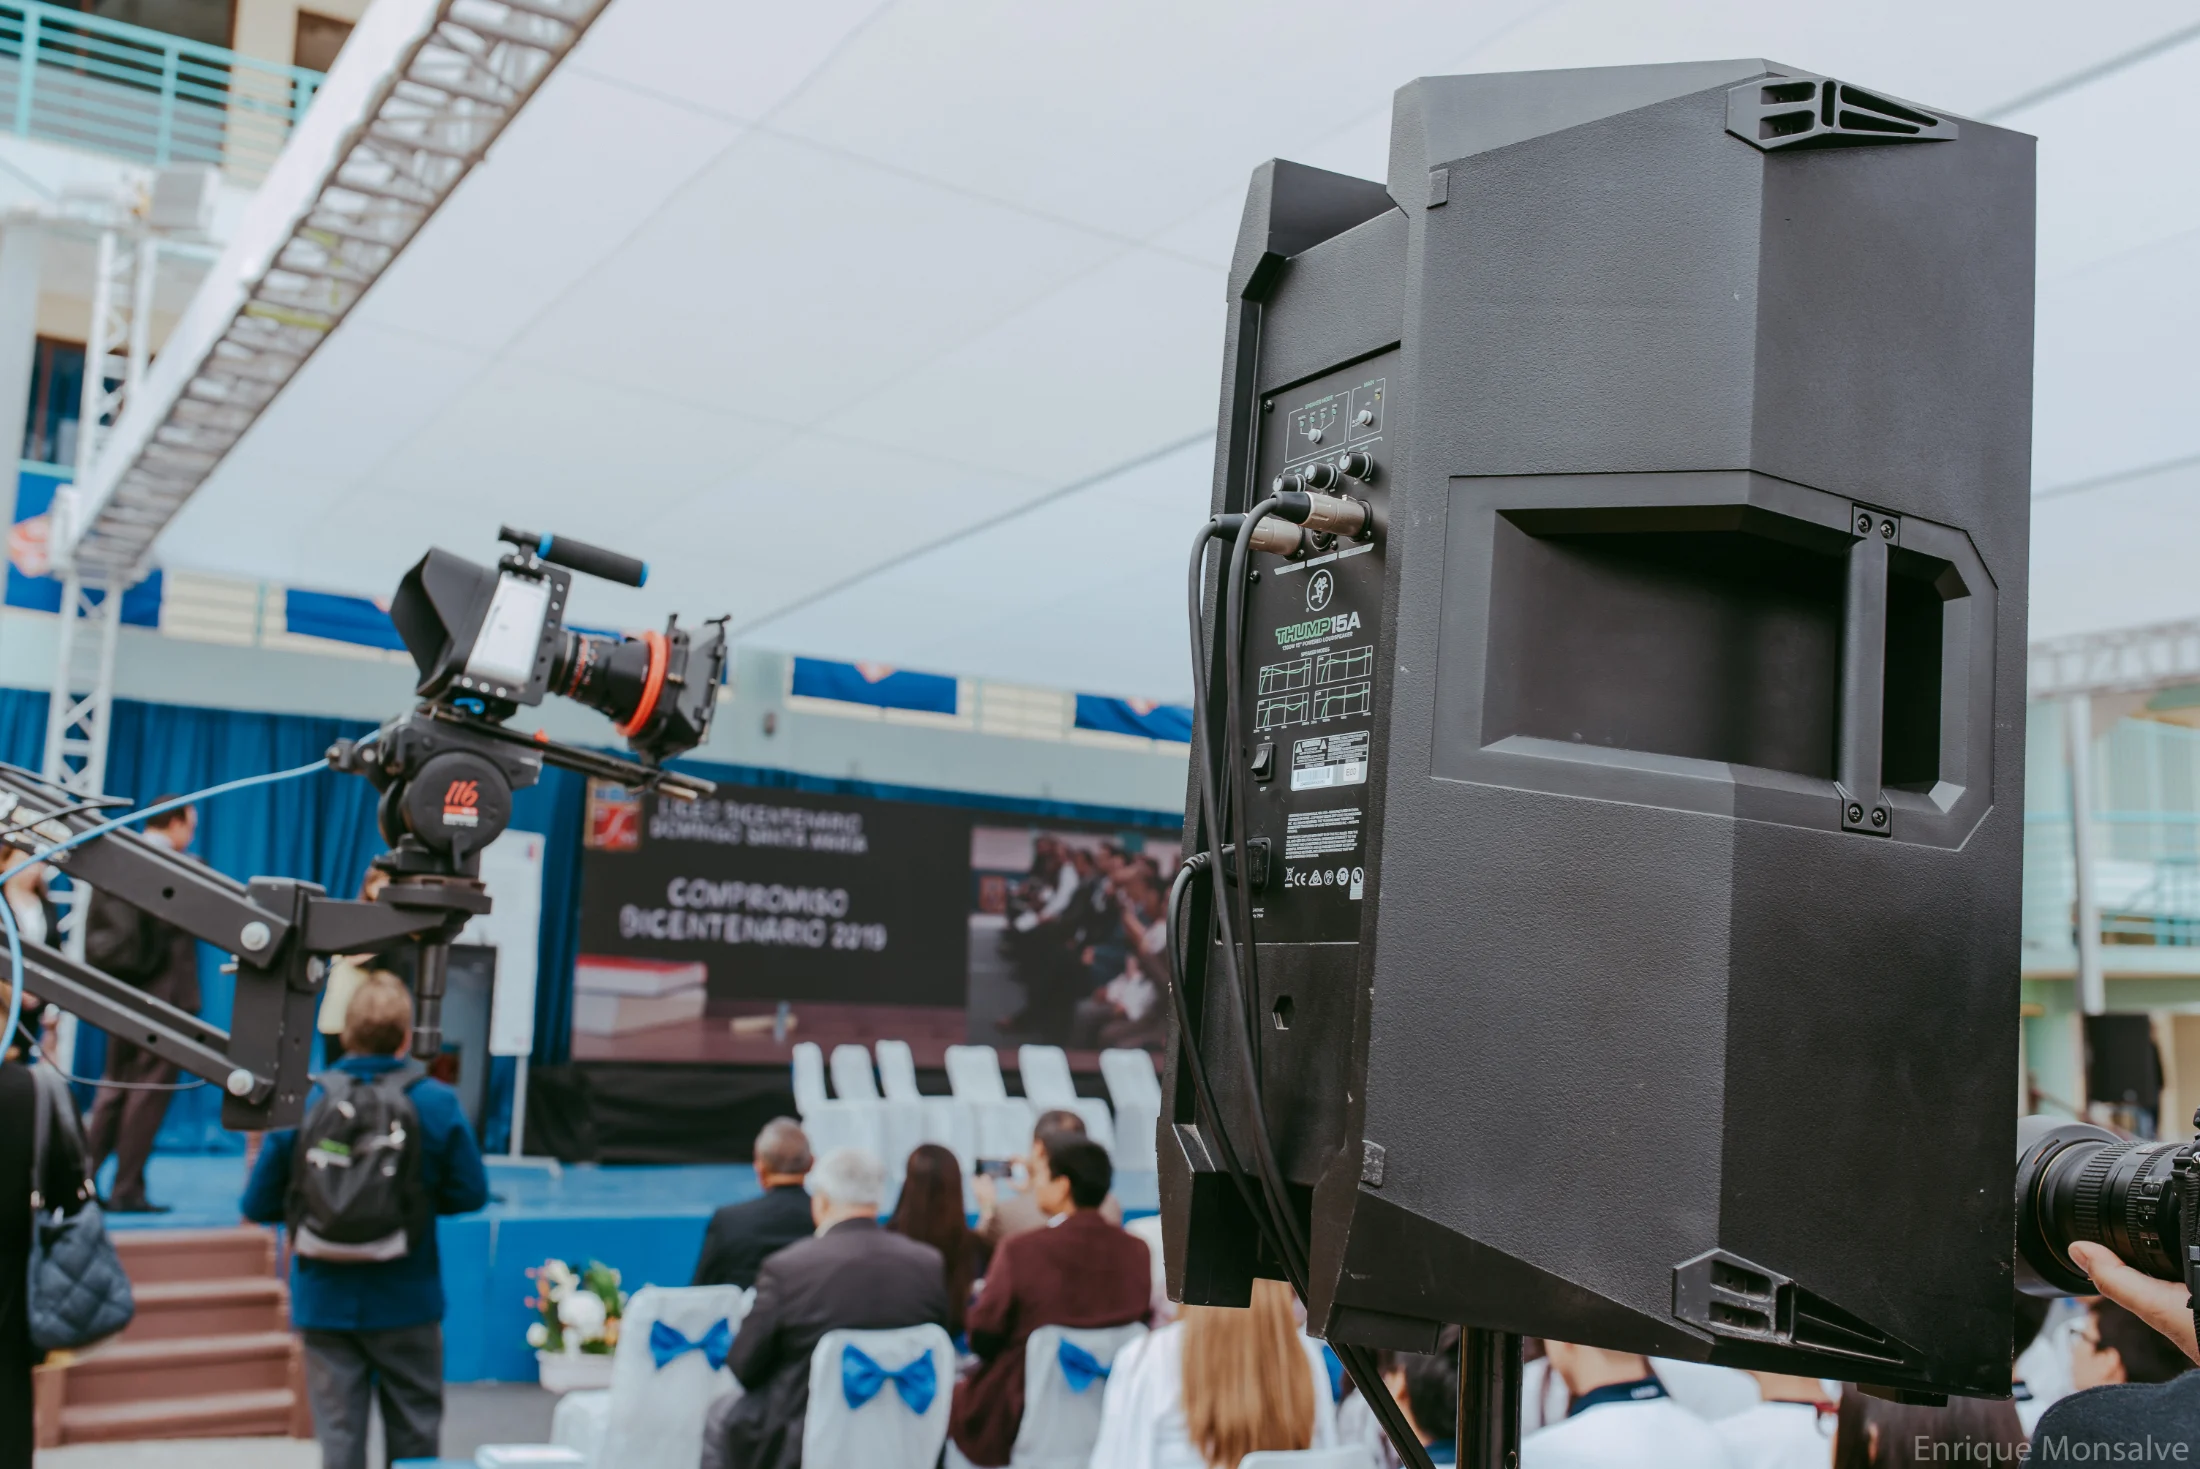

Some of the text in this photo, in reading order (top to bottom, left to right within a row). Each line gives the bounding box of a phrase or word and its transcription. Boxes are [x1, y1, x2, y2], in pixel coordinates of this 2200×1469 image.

[667, 876, 849, 918] COMPROMISO
[619, 903, 887, 951] BICENTENARIO 2019
